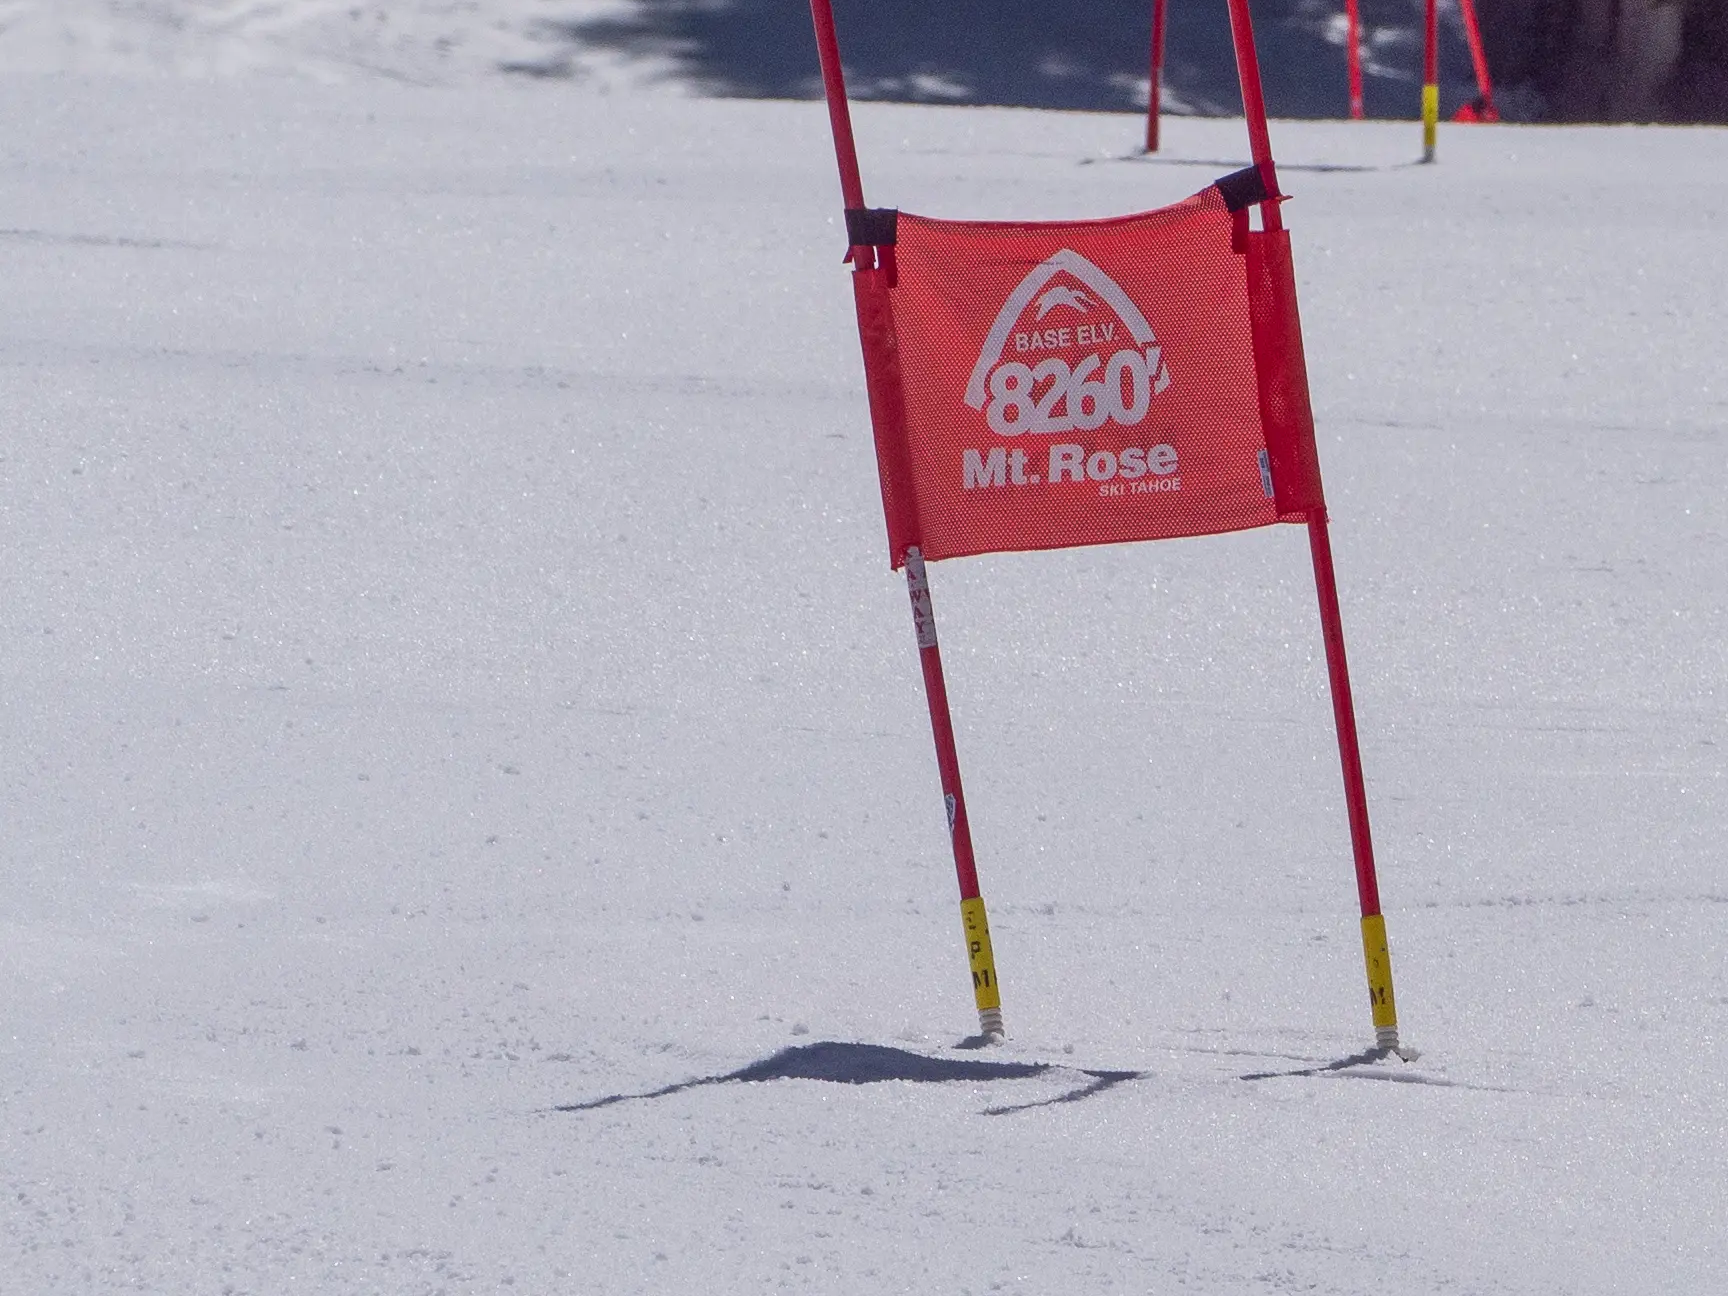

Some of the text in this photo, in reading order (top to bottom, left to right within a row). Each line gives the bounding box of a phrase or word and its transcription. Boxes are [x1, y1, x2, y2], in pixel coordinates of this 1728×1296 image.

[1015, 322, 1119, 352] BASE ELV.
[986, 346, 1162, 437] 8260'
[962, 443, 1179, 490] Mt. Rose
[1099, 476, 1181, 497] SKI TAHOE
